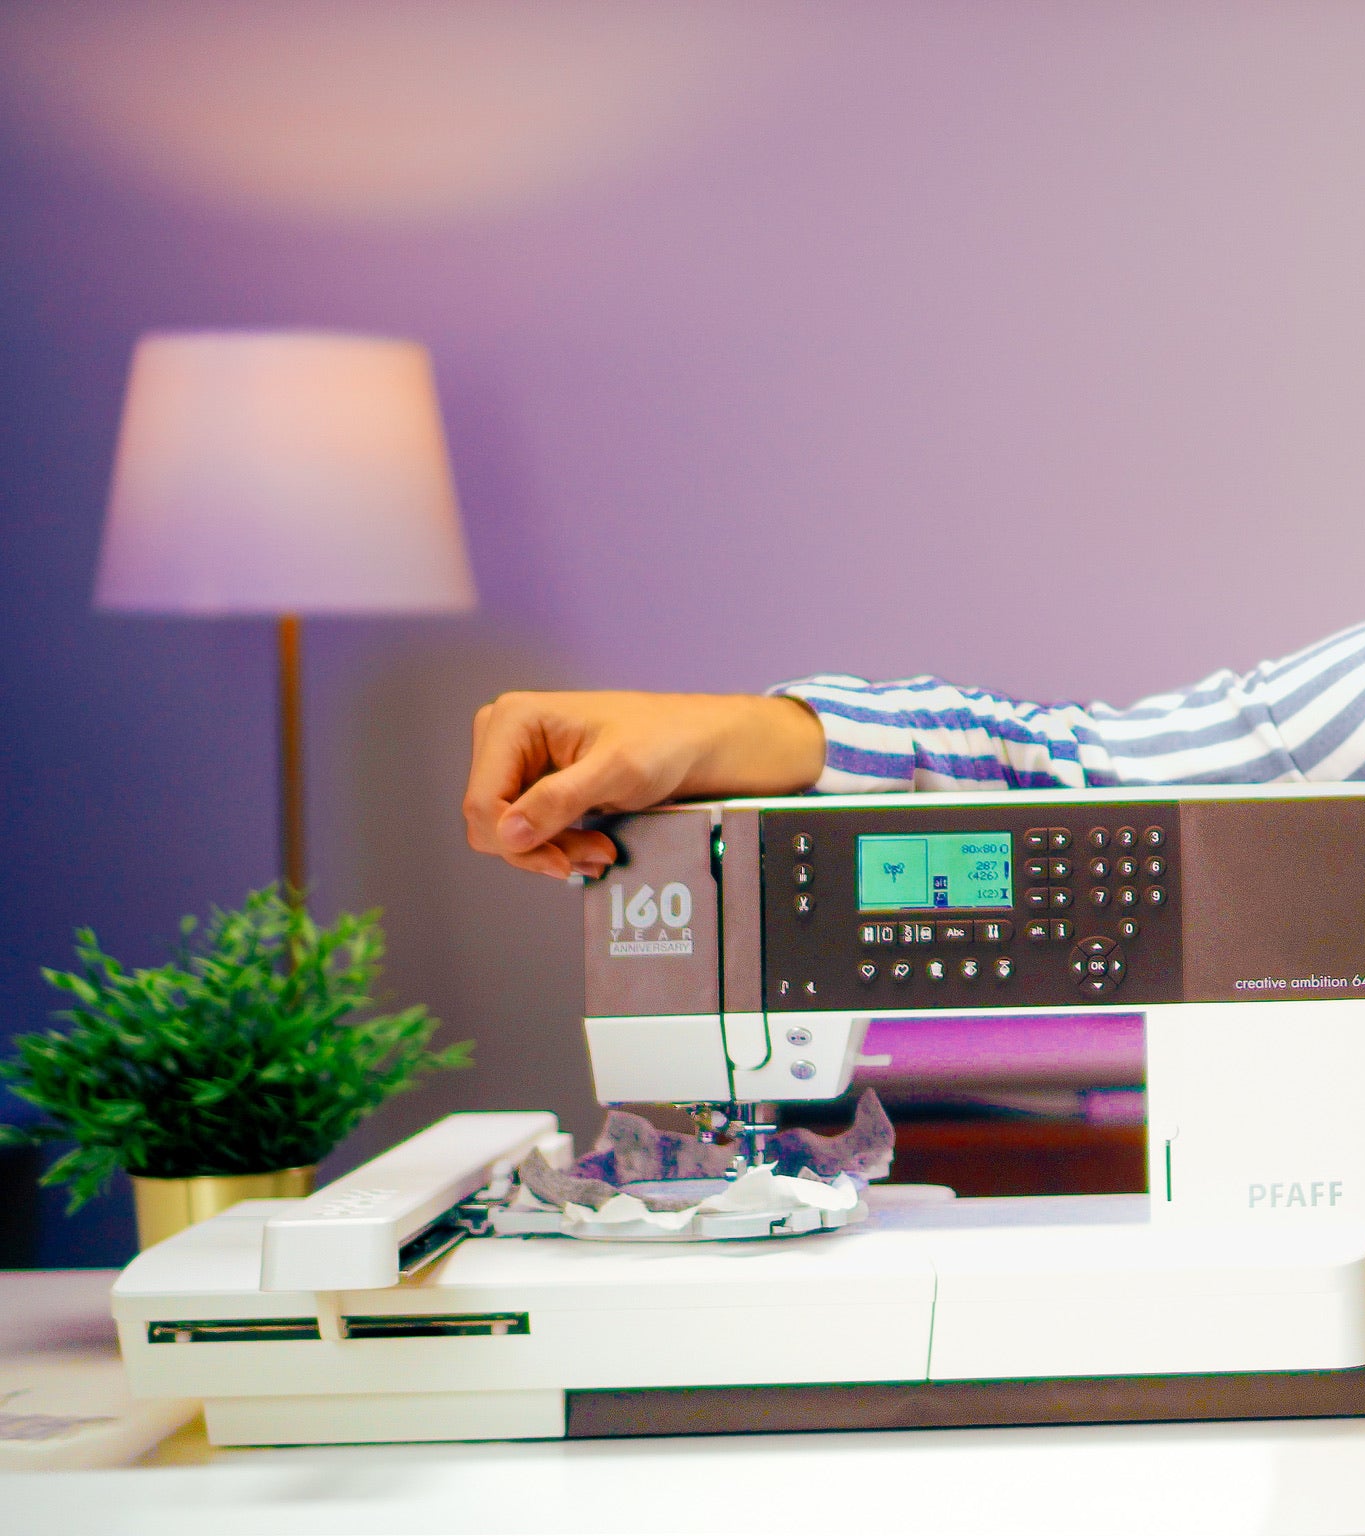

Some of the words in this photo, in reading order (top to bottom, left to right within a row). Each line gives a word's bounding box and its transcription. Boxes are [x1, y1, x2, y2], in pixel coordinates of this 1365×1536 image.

[1096, 833, 1103, 844] 1
[1124, 832, 1132, 843] 2
[1151, 831, 1160, 843] 3
[976, 861, 998, 871] 287
[1095, 862, 1104, 873] 4
[1124, 862, 1132, 873] 5
[1152, 861, 1160, 872] 6
[967, 871, 999, 881] (426)
[1096, 891, 1104, 902] 7
[1125, 891, 1133, 902] 8
[1152, 890, 1161, 901] 9
[609, 882, 693, 928] 160
[609, 927, 693, 942] YEAR
[946, 927, 965, 938] Abc
[1125, 923, 1133, 934] 0
[612, 942, 690, 954] ANNIVERSARY
[1090, 961, 1105, 971] OK
[1235, 976, 1287, 989] creative
[1290, 973, 1348, 988] ambition
[1248, 1180, 1343, 1208] PFAFF
